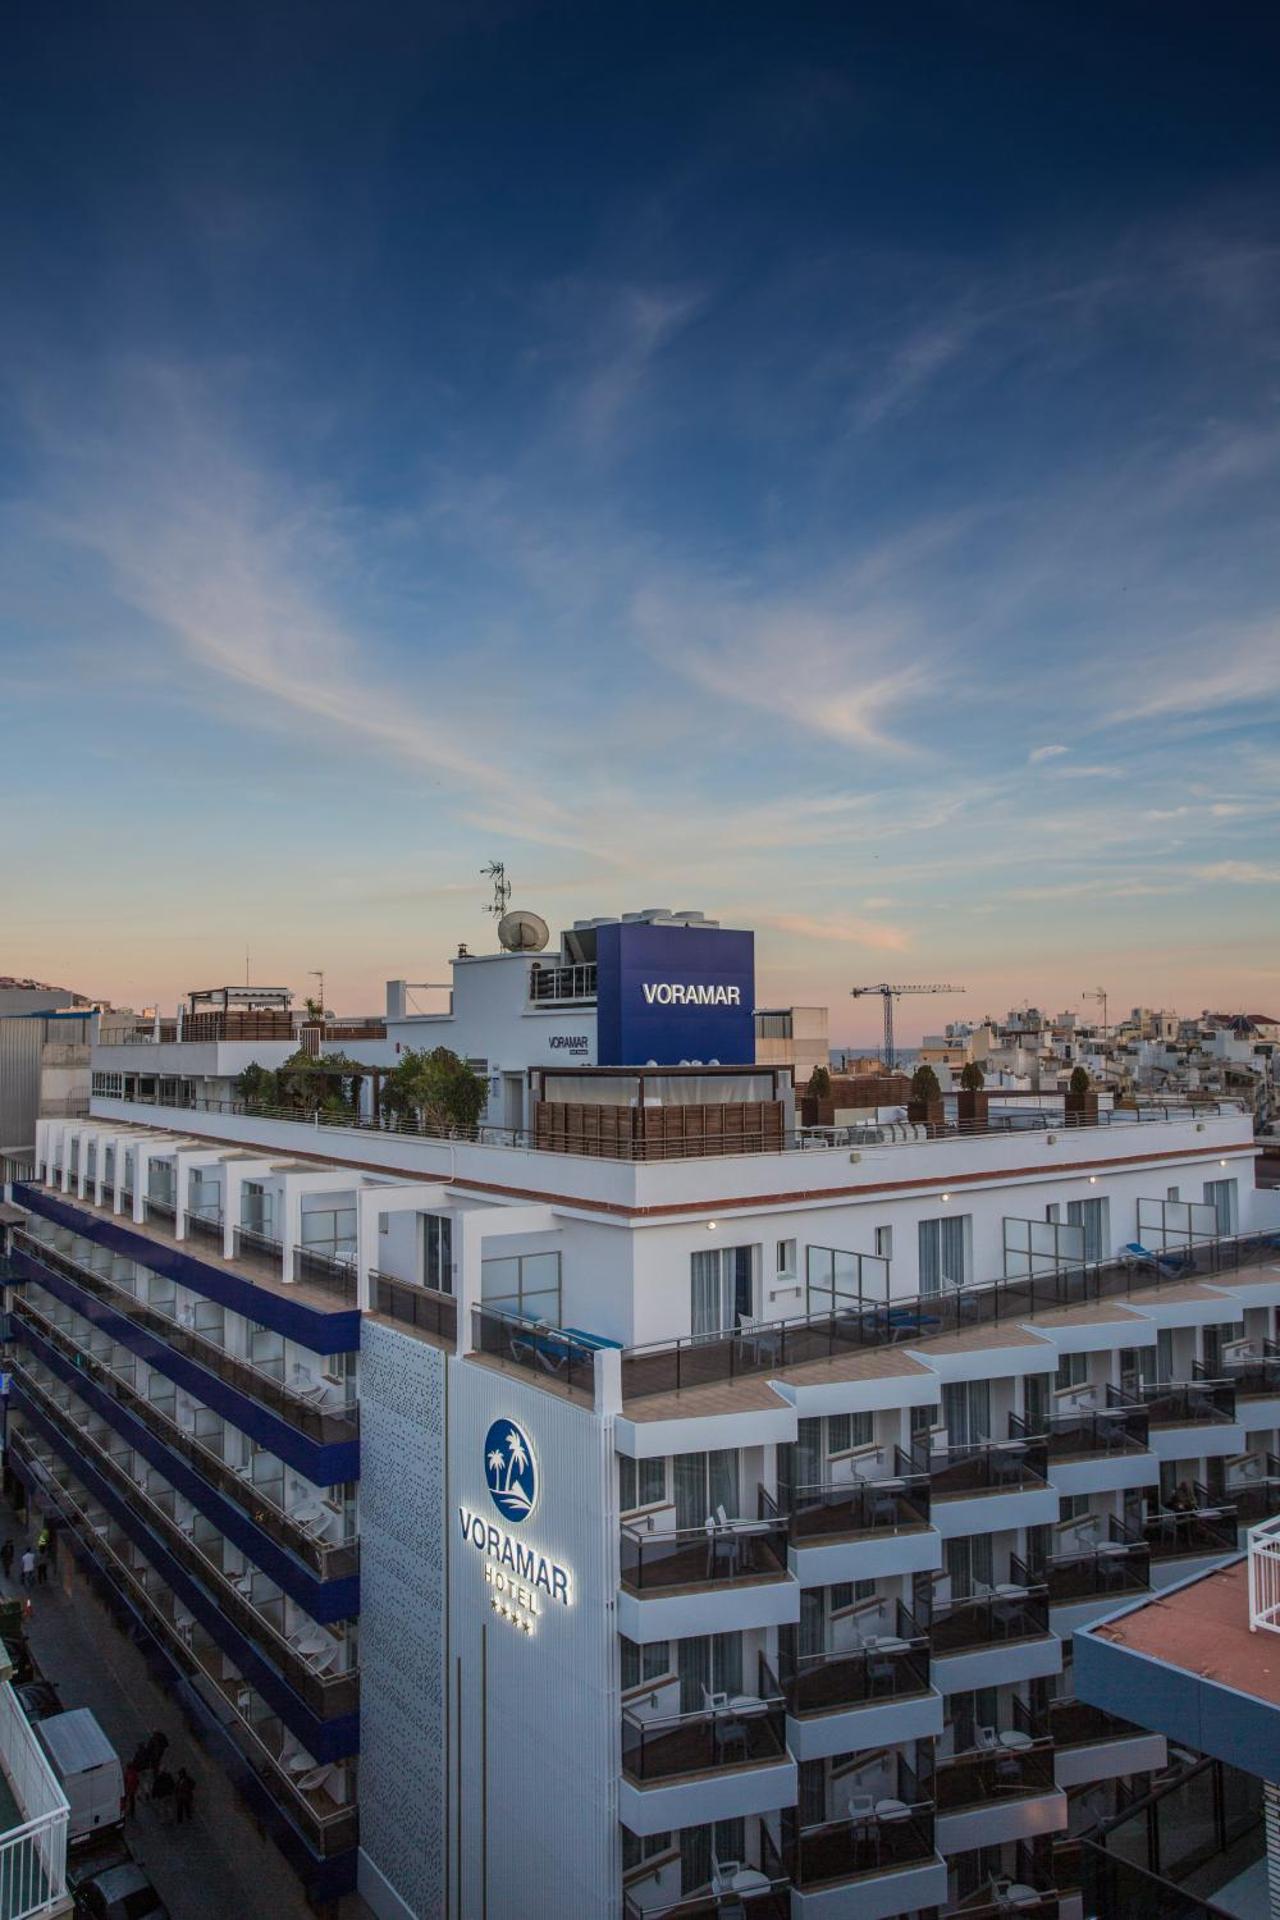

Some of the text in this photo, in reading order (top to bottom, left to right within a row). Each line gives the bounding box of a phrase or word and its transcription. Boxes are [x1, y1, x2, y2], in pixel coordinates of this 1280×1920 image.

[642, 983, 740, 1005] VORAMAR
[549, 1036, 588, 1049] VORAMAR
[459, 1508, 569, 1606] VORAMAR
[484, 1563, 537, 1615] HOTEL
